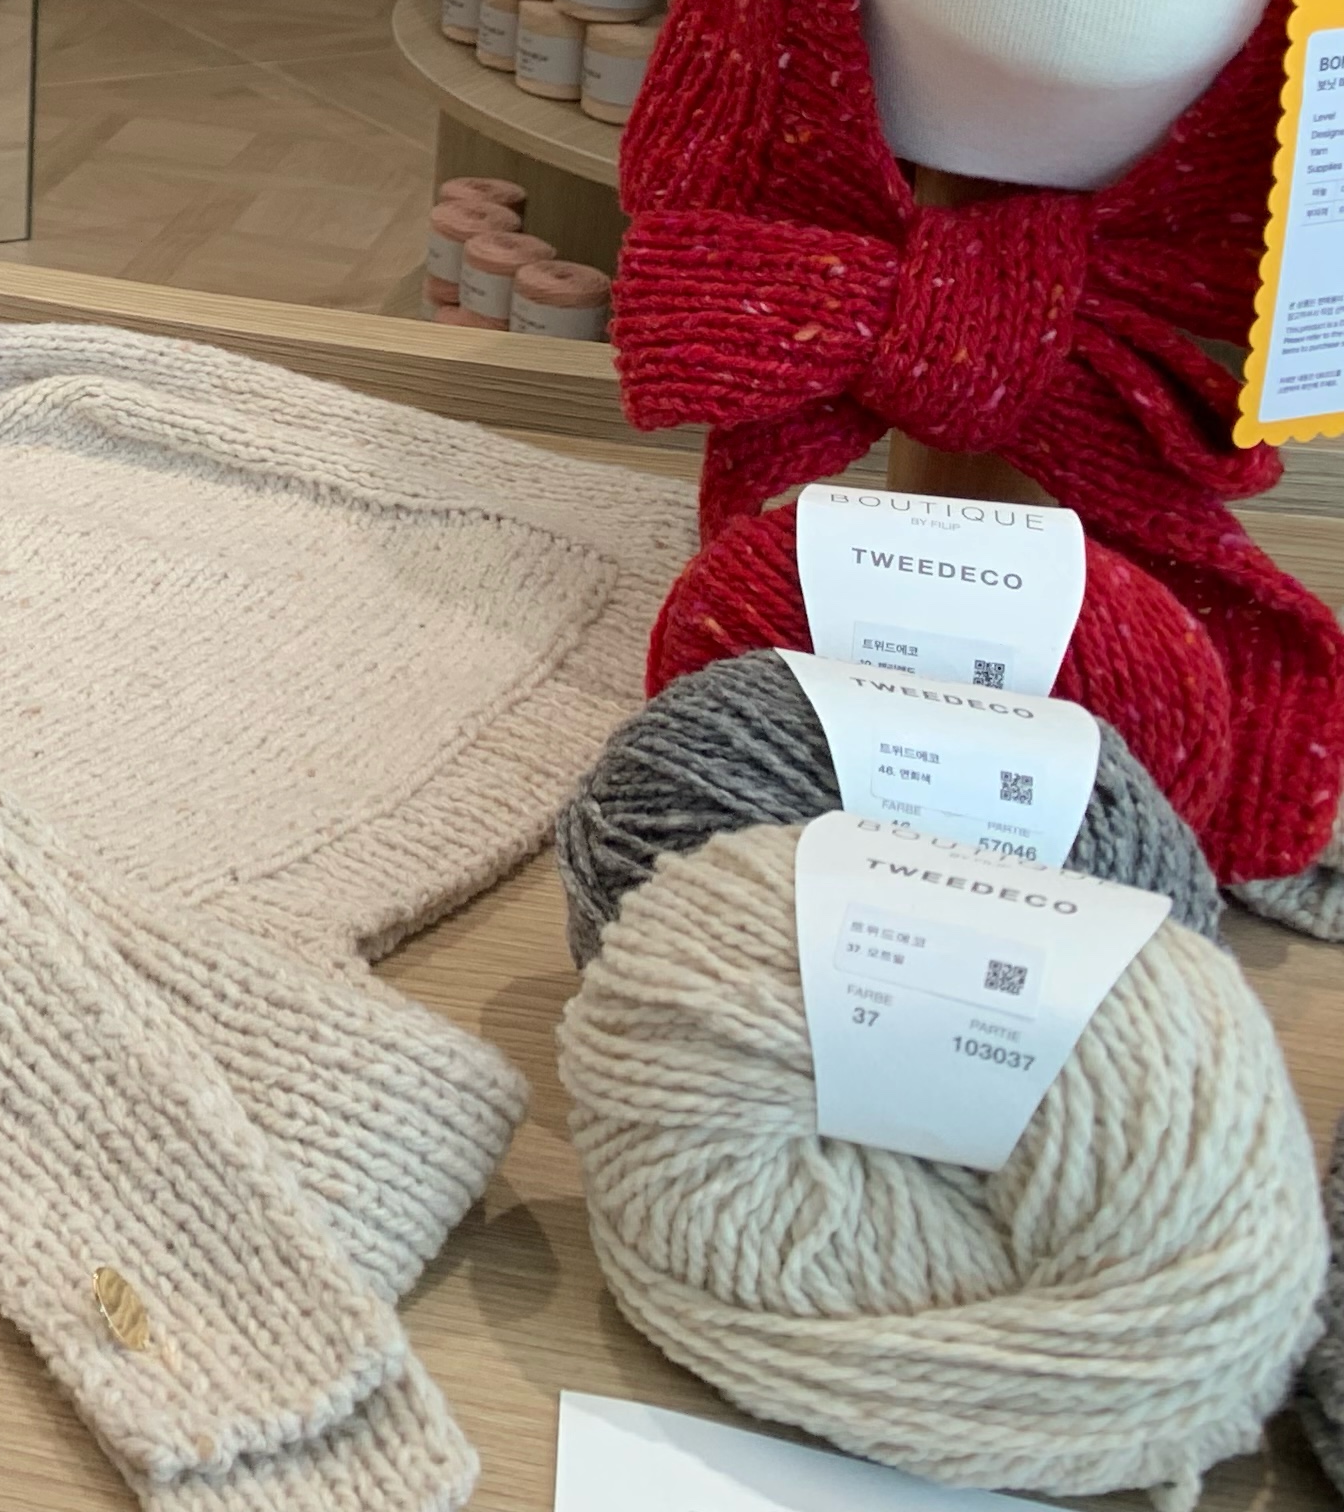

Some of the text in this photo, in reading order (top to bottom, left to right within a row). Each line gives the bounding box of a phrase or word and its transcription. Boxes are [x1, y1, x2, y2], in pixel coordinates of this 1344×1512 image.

[1313, 112, 1336, 122] Level
[1312, 129, 1344, 140] Designe
[830, 493, 1044, 532] BOUTIQUE
[911, 517, 928, 527] BY
[852, 547, 1023, 590] TWEEDECO
[862, 638, 919, 657] 트위드에코
[849, 677, 1035, 720] TWEEDECO
[879, 743, 940, 765] 트위드에코
[881, 800, 922, 816] FARBE
[987, 821, 1030, 839] PARTIE
[978, 837, 1037, 862] 57046
[866, 859, 1078, 915] TWEEDECO
[850, 921, 927, 949] 트위드에코
[846, 983, 894, 1007] FARBE
[851, 1006, 881, 1027] 37
[969, 1018, 1021, 1043] PARTIE
[952, 1036, 1036, 1072] 103037
